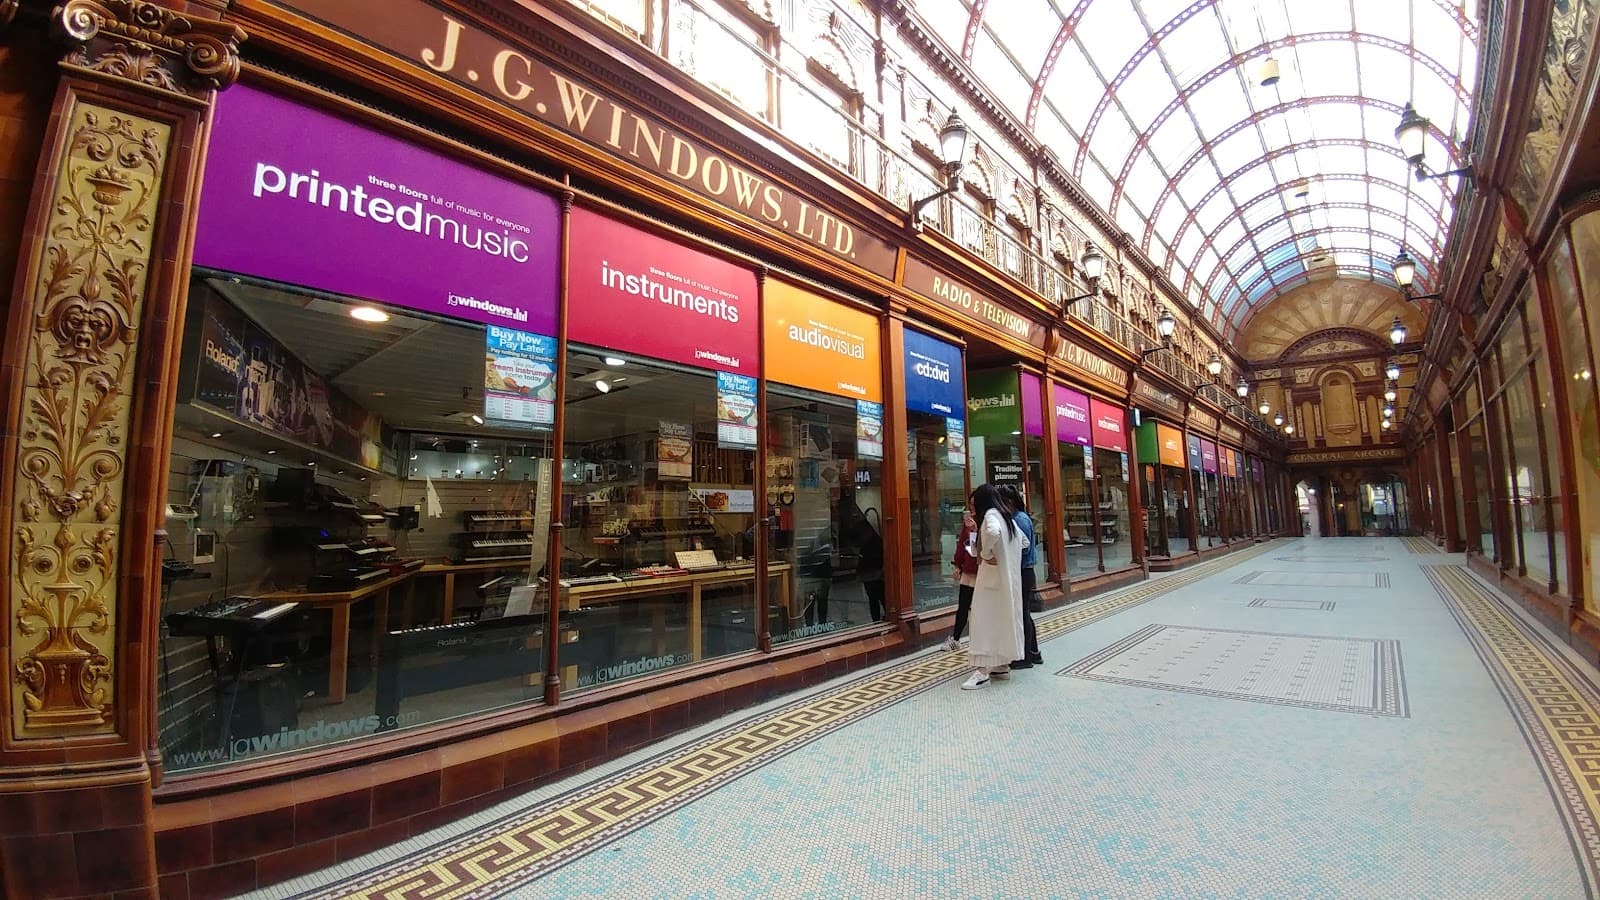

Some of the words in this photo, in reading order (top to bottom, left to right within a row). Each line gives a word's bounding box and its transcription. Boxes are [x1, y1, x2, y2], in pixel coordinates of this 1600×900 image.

[252, 161, 529, 263] printedmusic
[368, 175, 397, 191] three
[398, 184, 429, 201] floors
[430, 194, 443, 205] full
[445, 200, 454, 209] of
[456, 205, 482, 218] music
[483, 212, 494, 222] for
[495, 217, 531, 234] everyone
[601, 260, 739, 323] instruments
[932, 276, 972, 309] RADIO
[973, 300, 980, 313] &
[982, 300, 1030, 337] TELEVISION
[490, 326, 514, 342] Buy
[516, 331, 542, 345] Now
[499, 338, 519, 351] Pay
[520, 342, 545, 354] Later
[788, 324, 865, 360] audiovisual
[205, 339, 240, 373] Roland
[916, 362, 949, 384] cd:dvd
[994, 464, 1031, 473] Traditiol
[1293, 453, 1345, 462] CENTRAL
[1353, 448, 1397, 458] ARCADE
[994, 472, 1018, 481] pianos
[173, 710, 421, 767] www.jgwindows.com
